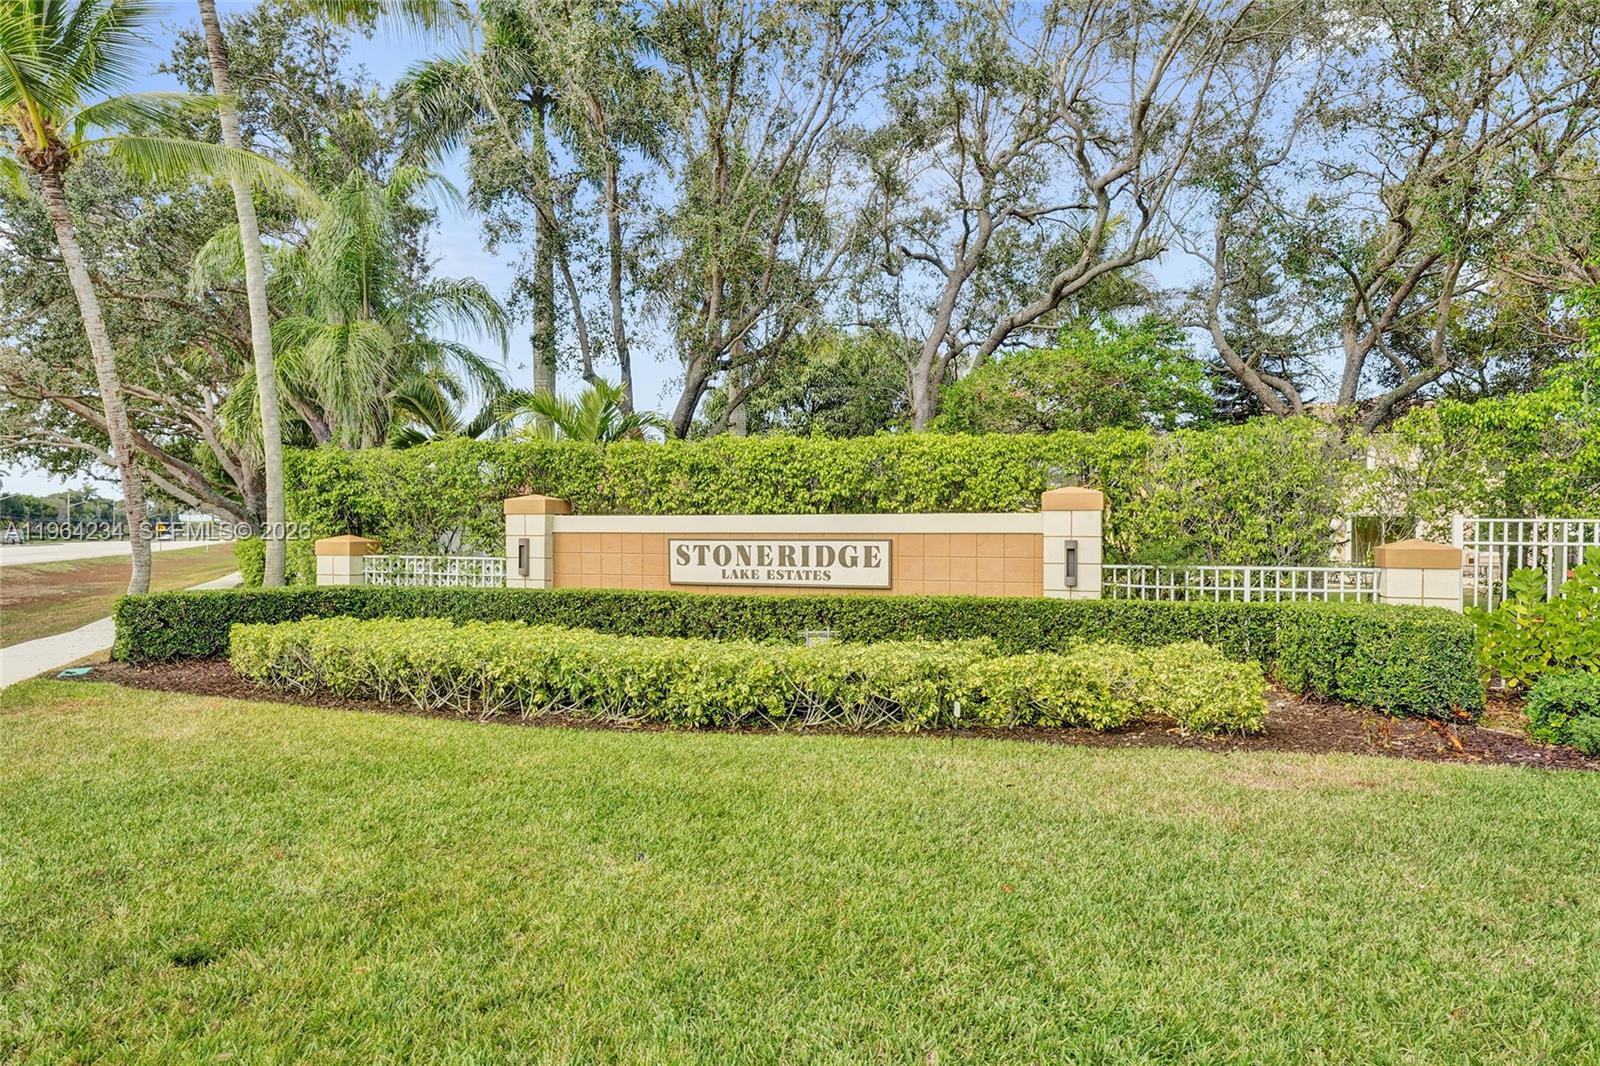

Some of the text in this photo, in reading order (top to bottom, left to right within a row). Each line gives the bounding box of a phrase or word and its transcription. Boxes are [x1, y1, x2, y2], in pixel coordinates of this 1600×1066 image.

[676, 544, 882, 568] STONERIDGE
[721, 569, 832, 581] LAKE ESTATES
